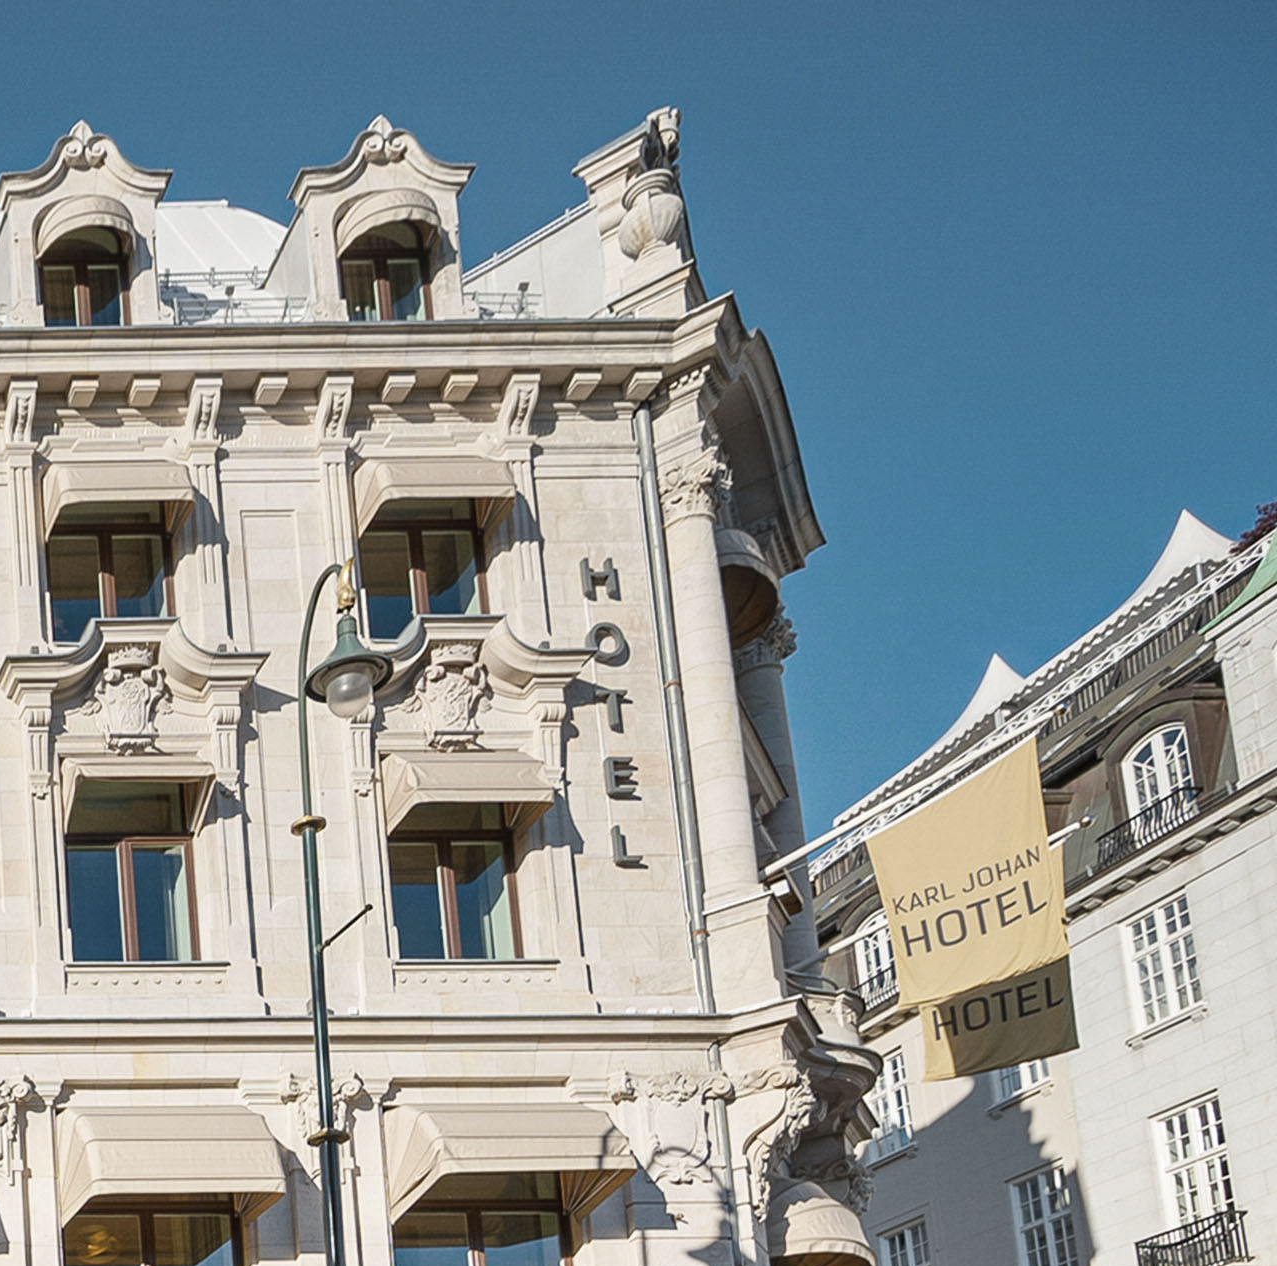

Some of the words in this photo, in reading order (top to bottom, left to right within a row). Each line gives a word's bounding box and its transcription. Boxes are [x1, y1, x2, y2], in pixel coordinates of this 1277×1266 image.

[579, 557, 647, 869] HOTEL
[892, 883, 955, 915] KARL
[962, 845, 1040, 893] JOHAN
[901, 880, 1047, 957] HOTEL
[932, 977, 1064, 1041] HOTEL
